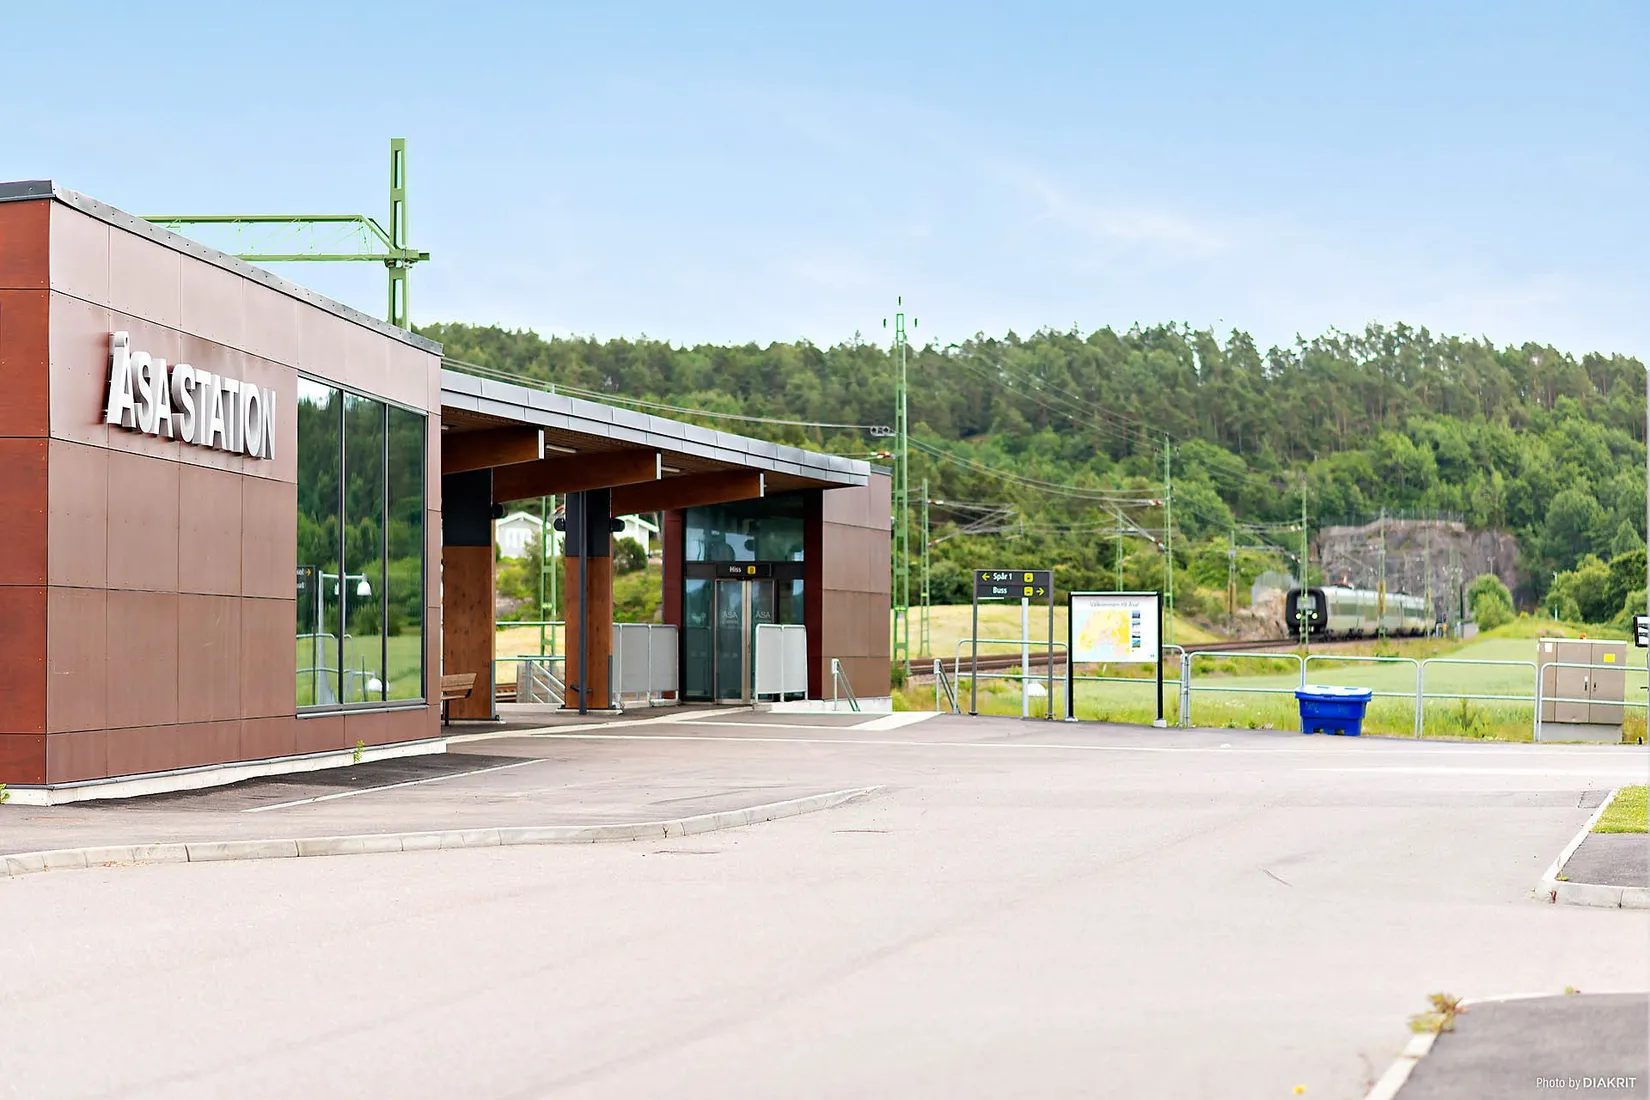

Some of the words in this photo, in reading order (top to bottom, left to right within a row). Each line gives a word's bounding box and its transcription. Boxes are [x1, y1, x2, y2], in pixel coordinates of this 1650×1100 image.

[106, 331, 174, 438] ÅSA
[171, 363, 276, 460] STATION
[729, 565, 742, 573] Hiss
[992, 572, 1008, 581] Spår
[992, 586, 1008, 594] Buss
